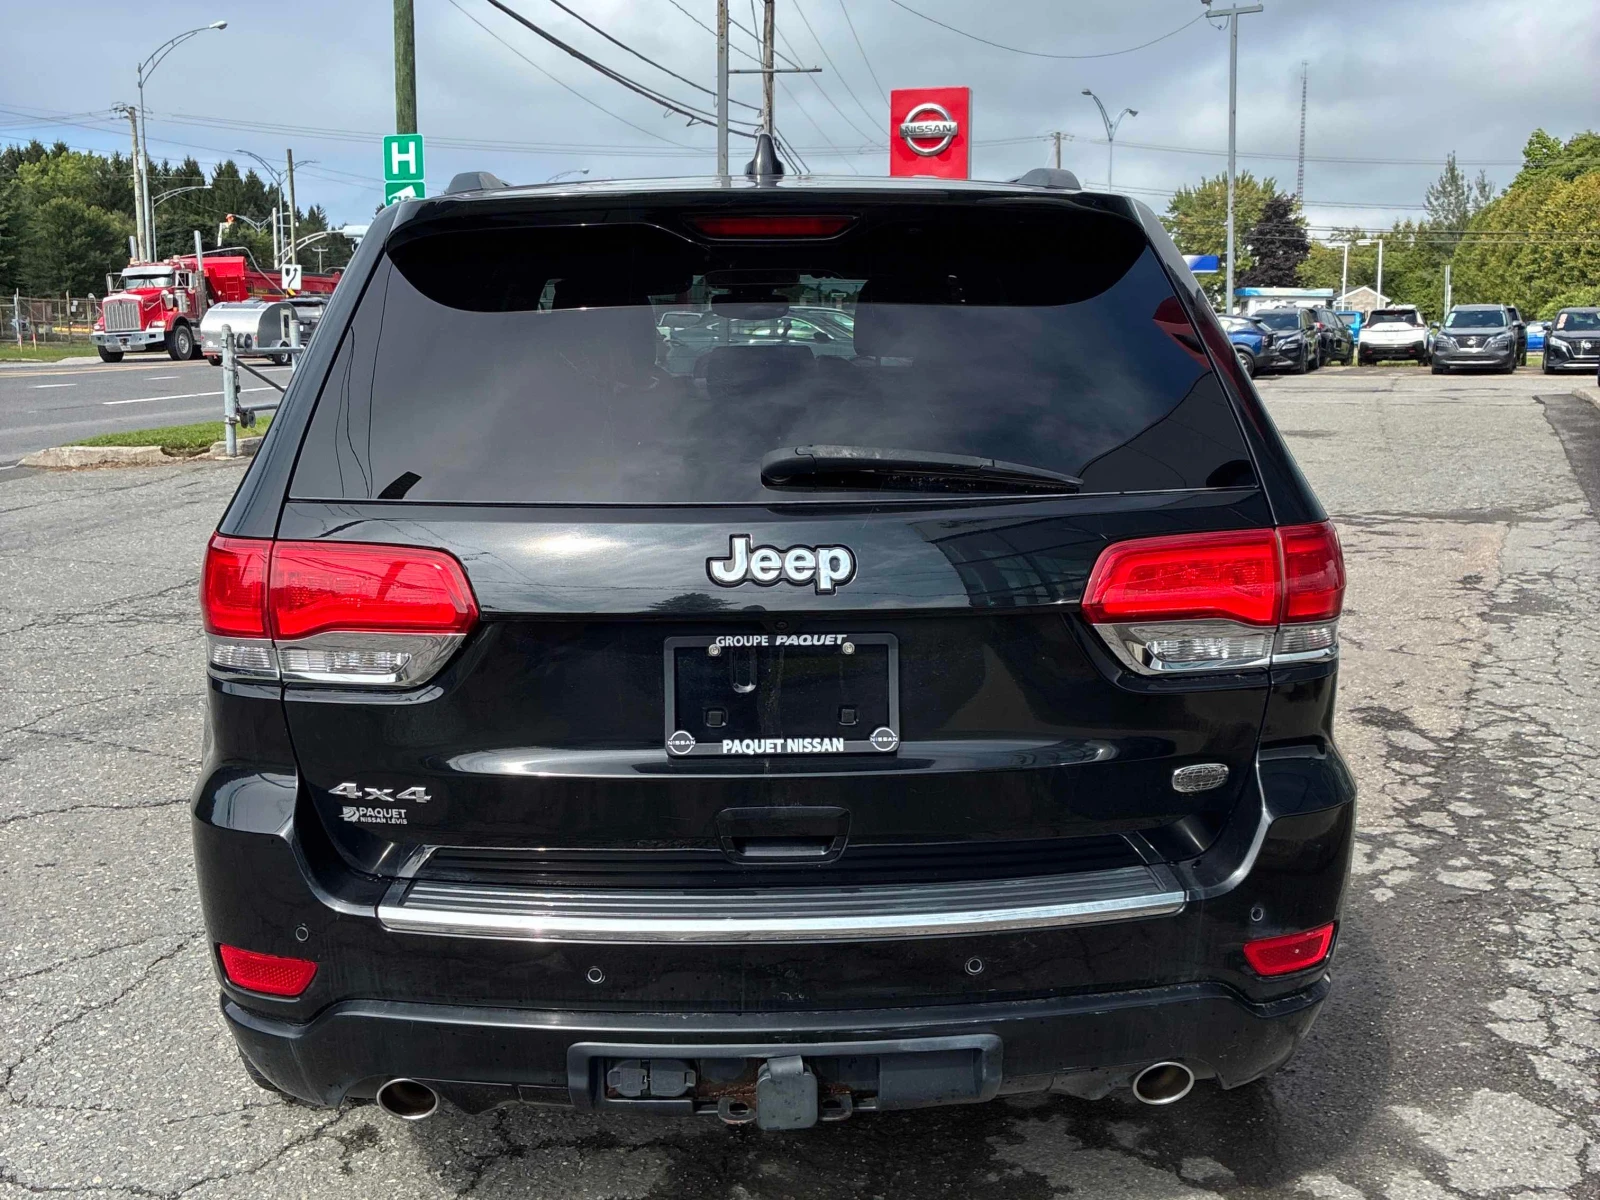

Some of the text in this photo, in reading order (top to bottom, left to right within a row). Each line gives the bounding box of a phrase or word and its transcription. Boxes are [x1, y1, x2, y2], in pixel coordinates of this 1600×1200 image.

[904, 124, 952, 134] NISSAN
[391, 141, 417, 175] H
[708, 536, 854, 593] Jeep
[715, 634, 847, 647] GROUPE PAQUET
[722, 737, 844, 755] PAQUET NISSAN
[359, 806, 407, 818] PAQUET
